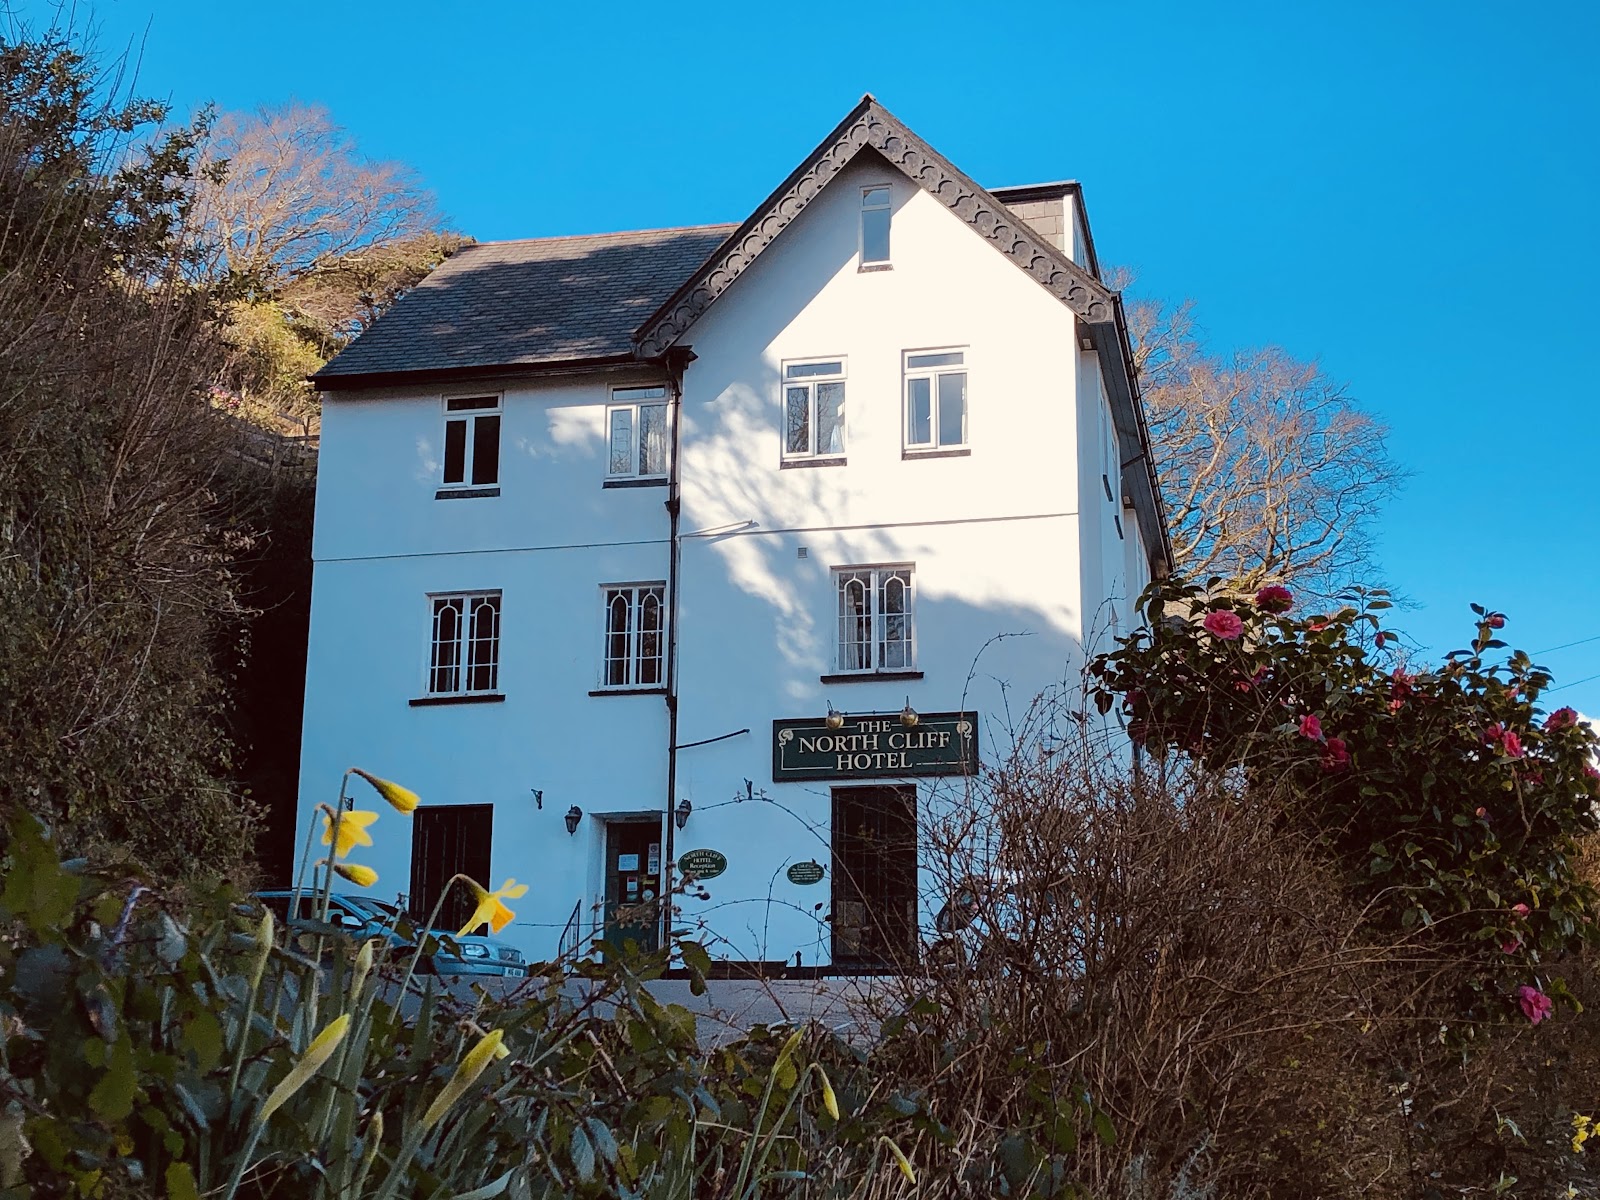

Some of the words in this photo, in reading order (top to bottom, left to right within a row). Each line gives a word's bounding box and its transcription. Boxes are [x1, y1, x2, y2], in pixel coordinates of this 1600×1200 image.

[857, 720, 892, 733] THE
[798, 734, 879, 754] NORTH
[888, 731, 951, 750] CLIFF
[836, 752, 913, 771] HOTEL
[684, 851, 704, 861] NORTH
